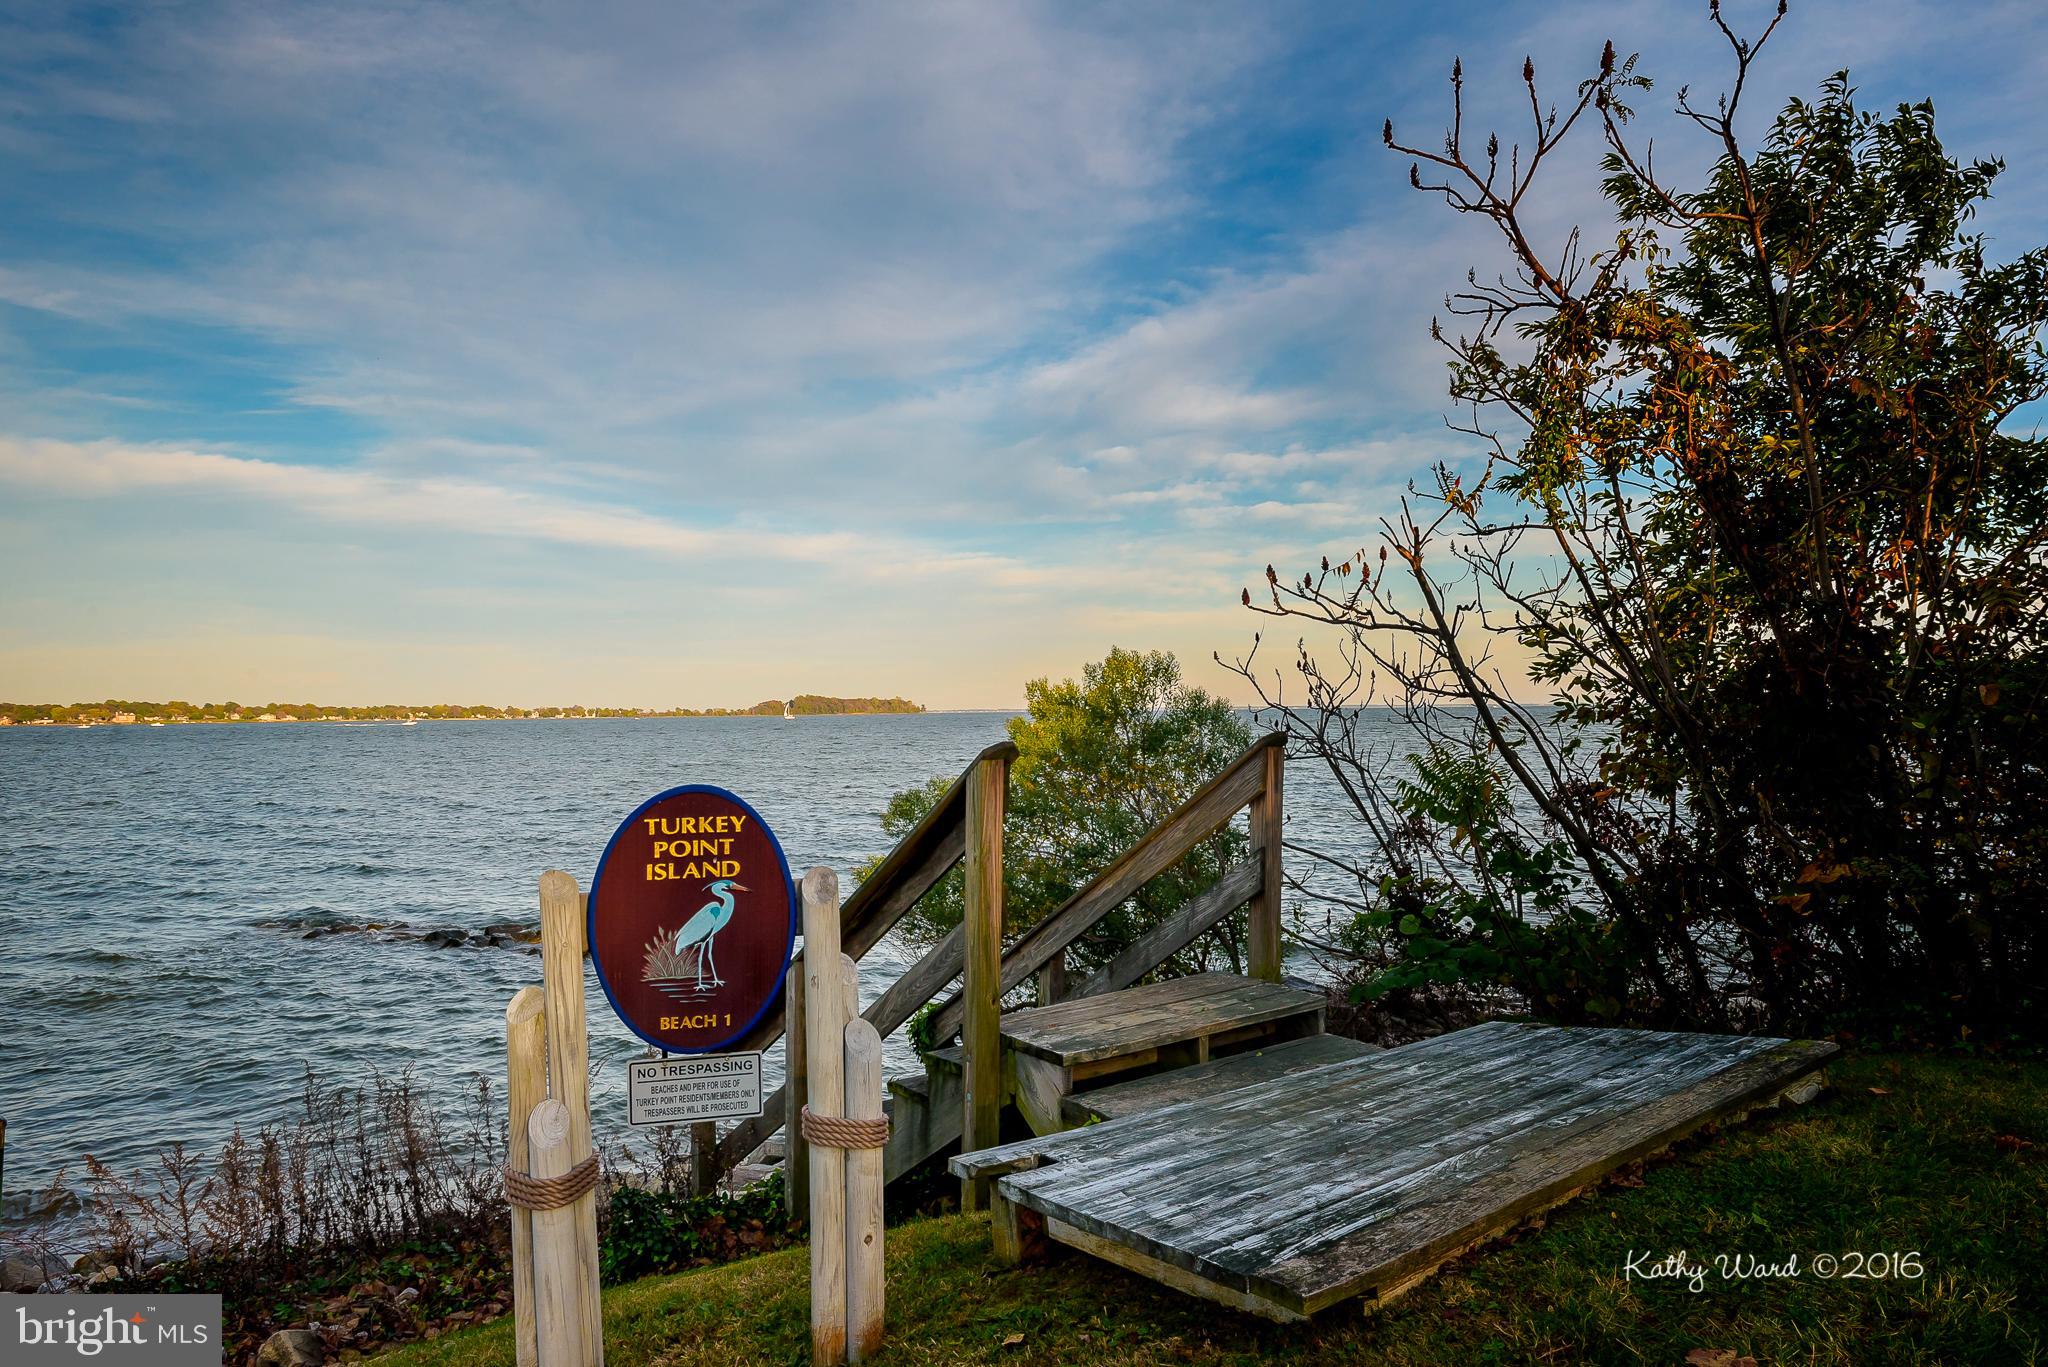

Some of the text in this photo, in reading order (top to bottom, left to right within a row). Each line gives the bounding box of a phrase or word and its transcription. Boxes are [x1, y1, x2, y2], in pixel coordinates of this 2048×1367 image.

[644, 815, 746, 835] TURKEY
[654, 838, 734, 858] POINT
[646, 860, 741, 880] ISLAND
[660, 1013, 731, 1030] BEACH 1
[637, 1060, 753, 1079] NO TRESPASSING
[650, 1079, 741, 1095] BEACHES AND PIER FOR USE OF
[636, 1097, 659, 1107] TURKEY
[660, 1096, 677, 1105] POINT
[740, 1089, 756, 1098] ONLY
[644, 1101, 749, 1118] TRESPASSERS WILL BE PROSECUTED
